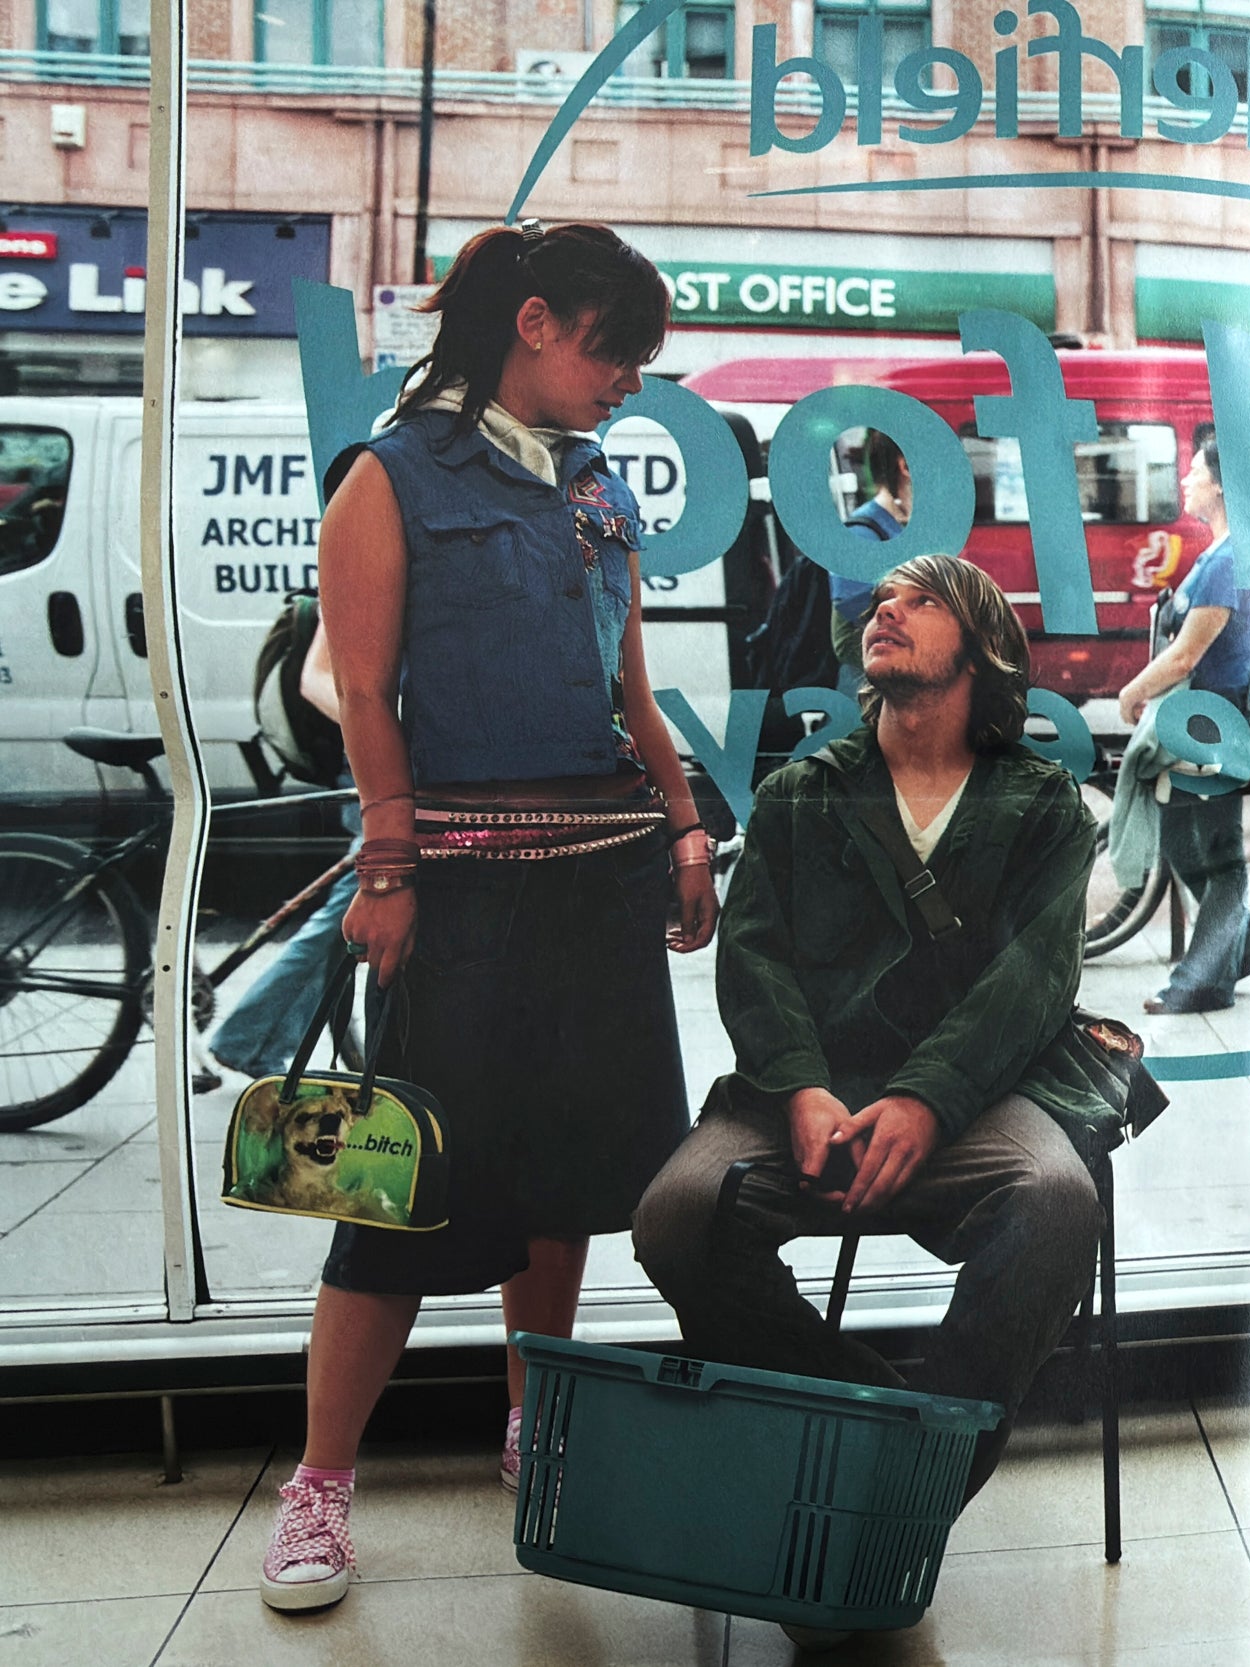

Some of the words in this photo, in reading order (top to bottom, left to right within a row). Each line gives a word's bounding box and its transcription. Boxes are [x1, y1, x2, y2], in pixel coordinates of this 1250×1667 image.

[658, 272, 731, 311] ST
[739, 273, 896, 317] OFFICE
[203, 455, 307, 496] JMF
[608, 455, 678, 496] TD
[347, 1133, 413, 1157] ...bitch
